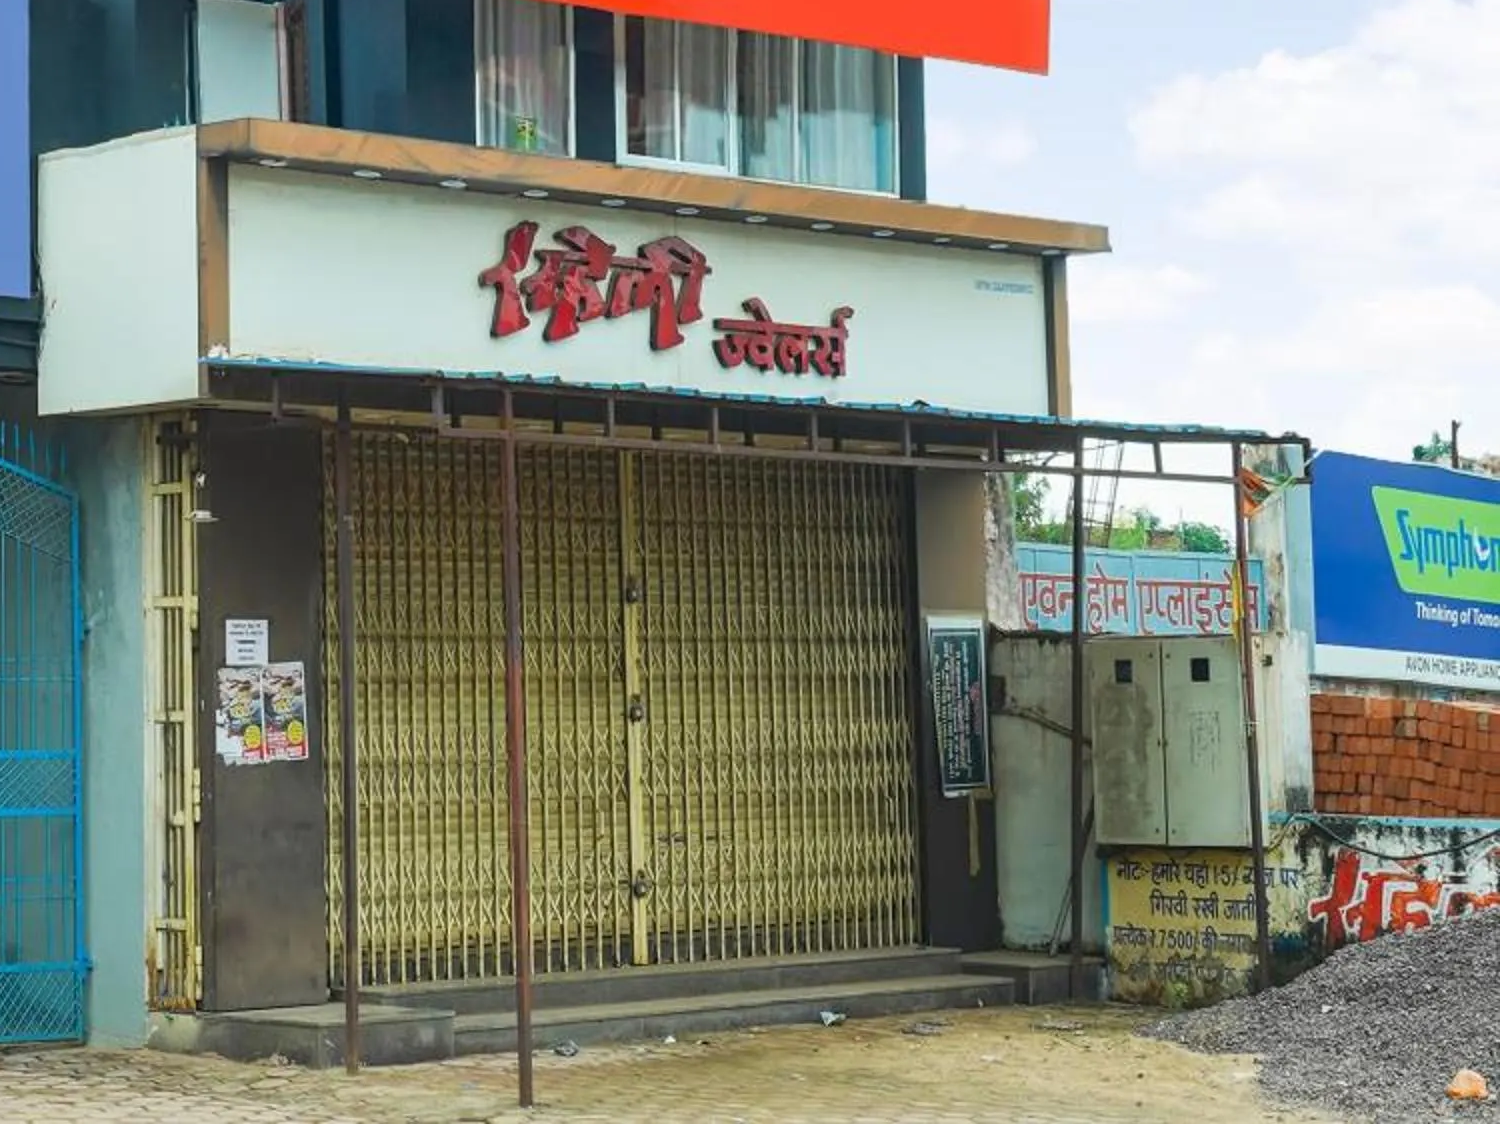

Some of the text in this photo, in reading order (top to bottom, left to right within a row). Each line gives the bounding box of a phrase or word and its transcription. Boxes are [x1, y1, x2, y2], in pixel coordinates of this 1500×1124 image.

[712, 297, 854, 376] ज्वेलर्स
[1086, 562, 1129, 633] होम
[1415, 601, 1459, 627] Thinking
[1460, 607, 1471, 625] of
